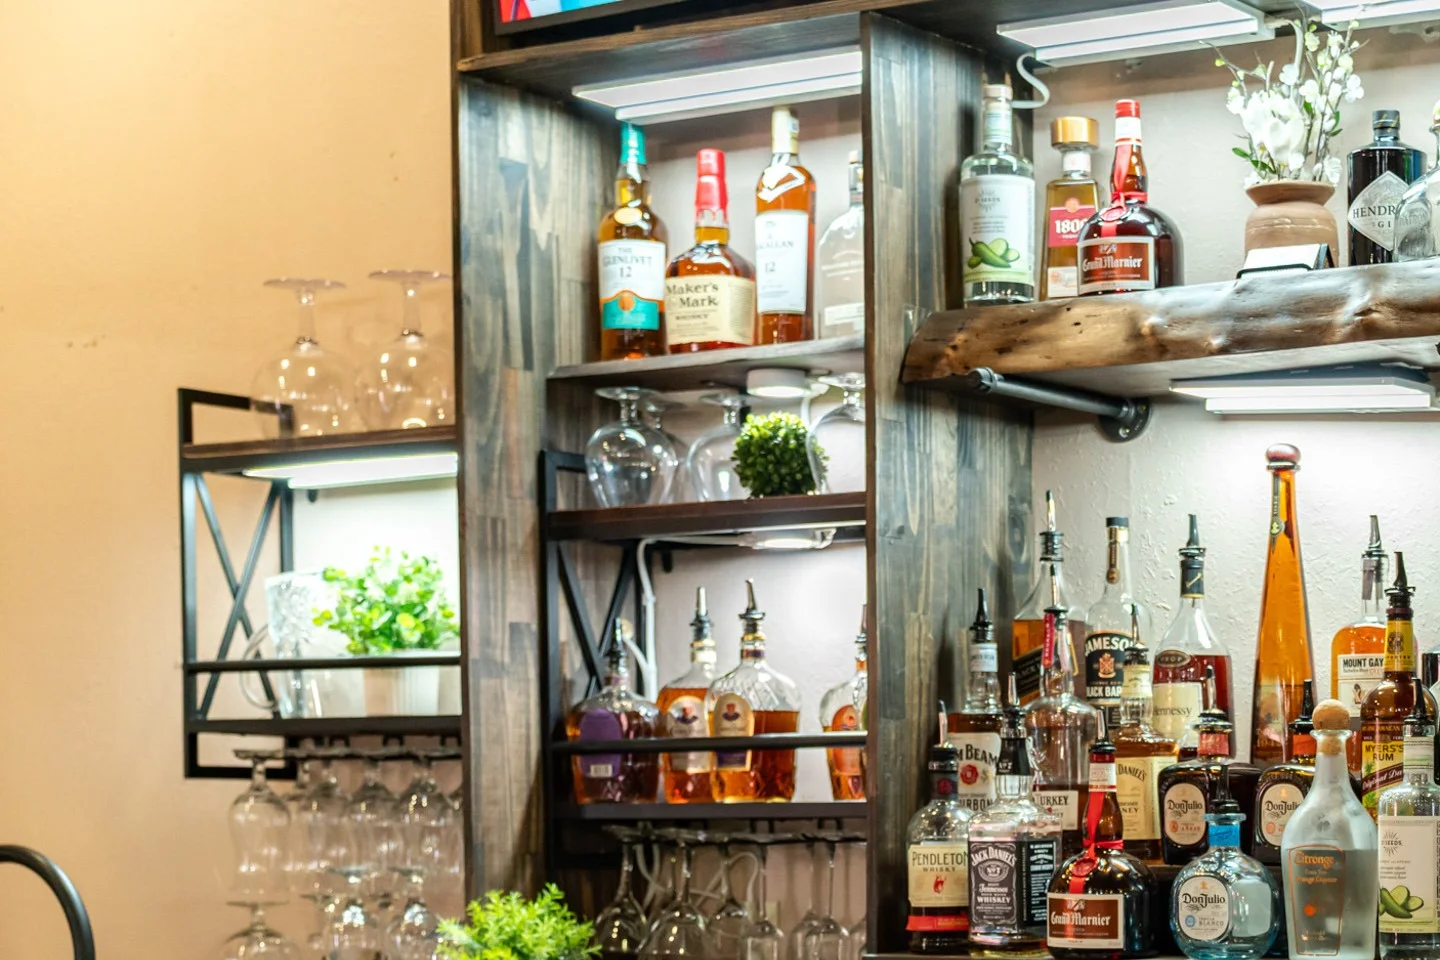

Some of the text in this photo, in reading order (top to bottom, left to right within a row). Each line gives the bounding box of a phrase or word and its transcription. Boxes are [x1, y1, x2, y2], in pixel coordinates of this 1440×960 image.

[1082, 254, 1143, 272] Grand Marnier
[666, 282, 719, 295] Maker's
[680, 296, 718, 308] Mark
[1343, 657, 1384, 669] MOUNT GAY
[965, 744, 998, 765] BEAM
[1373, 753, 1394, 762] RUM
[1117, 763, 1147, 782] DANIEL'S
[1168, 799, 1203, 814] Don Julio
[1265, 800, 1282, 811] Don
[911, 851, 968, 867] PENDLETON
[970, 846, 1017, 867] JACK DANIEL'S
[977, 896, 1011, 904] WHISKEY
[1182, 892, 1226, 909] Don Julio
[1051, 911, 1111, 927] Grand Marnier
